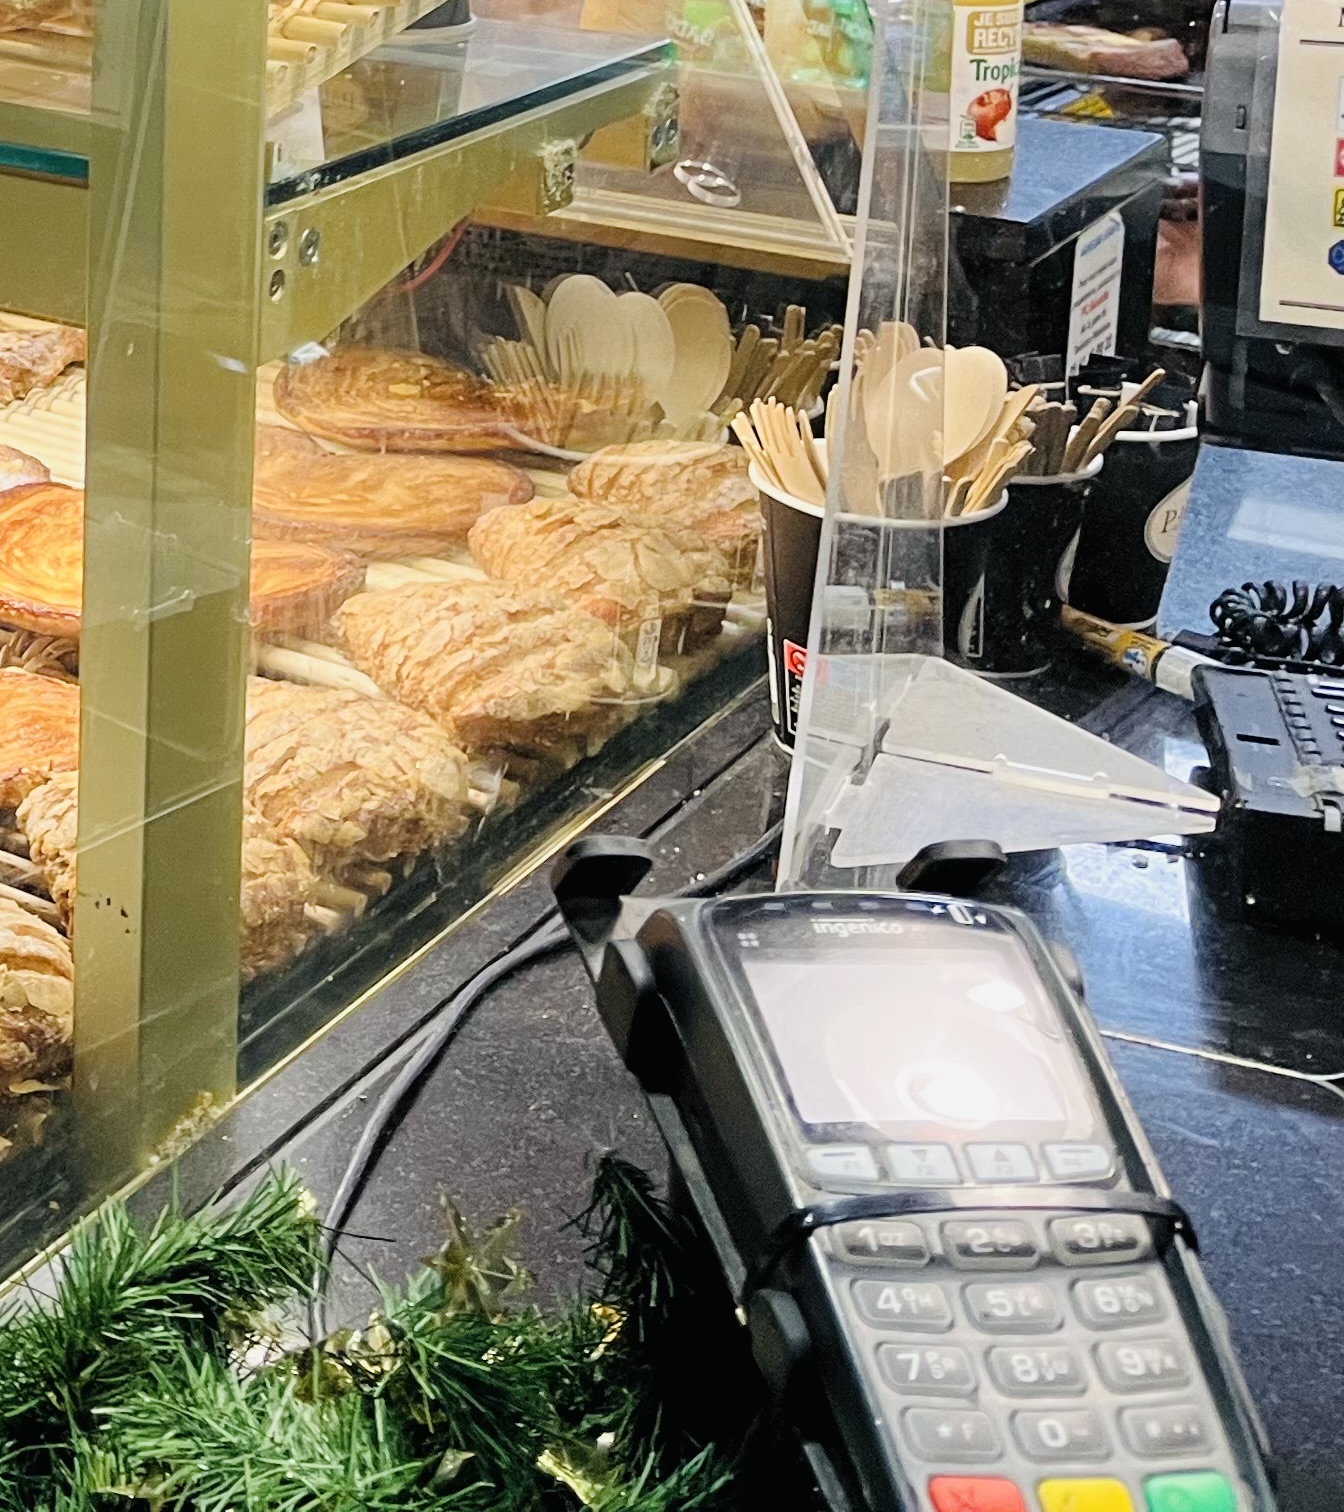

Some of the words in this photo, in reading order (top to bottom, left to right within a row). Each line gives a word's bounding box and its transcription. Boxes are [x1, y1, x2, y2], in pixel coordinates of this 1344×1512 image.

[973, 12, 993, 27] JE
[812, 920, 904, 938] ingenico
[965, 1227, 993, 1253] 2
[1072, 1223, 1099, 1249] 3
[876, 1287, 902, 1314] 4
[986, 1290, 1014, 1317] 5
[1093, 1286, 1120, 1314] 6
[896, 1352, 920, 1381] 7
[1012, 1354, 1039, 1383] 8
[1116, 1348, 1145, 1376] 9
[1037, 1418, 1067, 1448] 0
